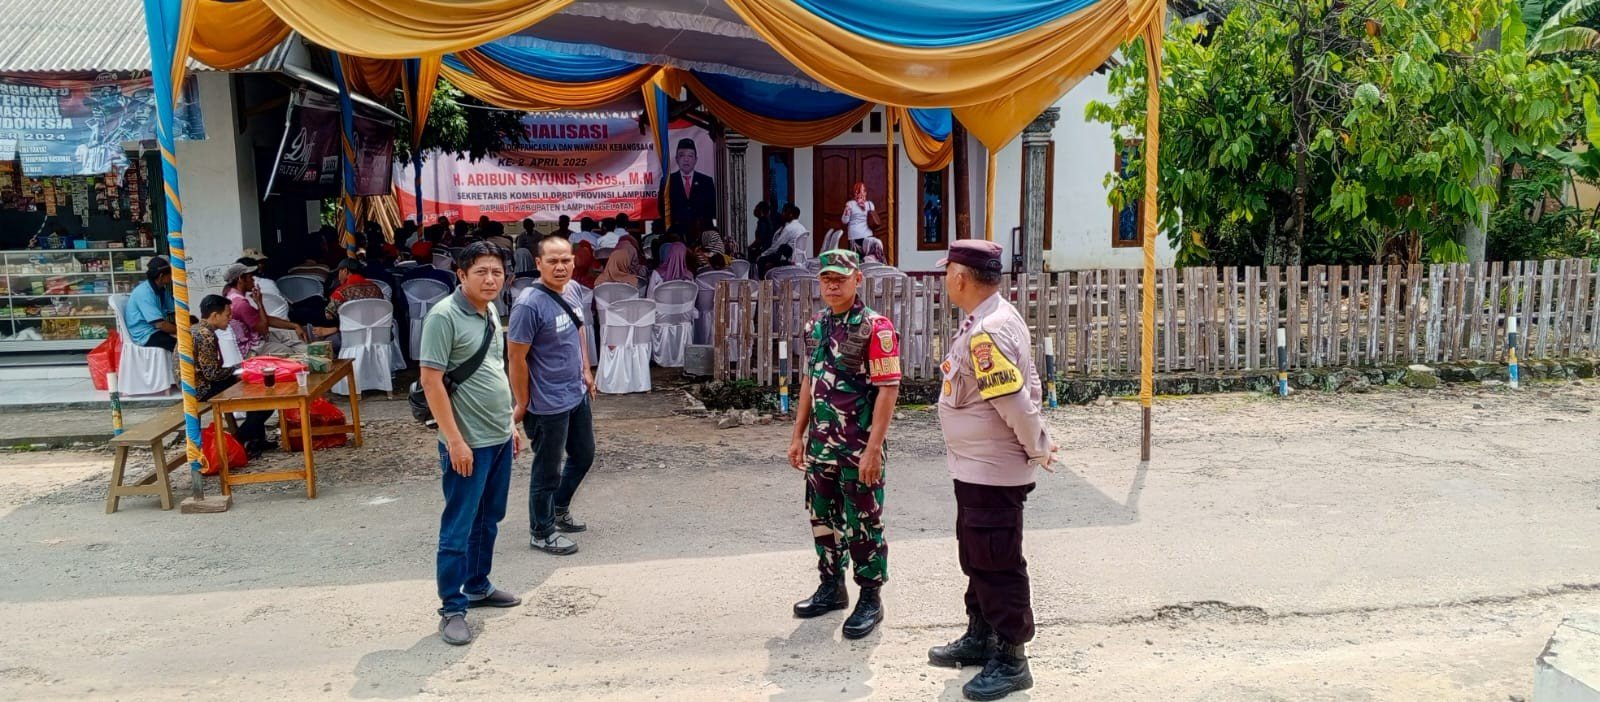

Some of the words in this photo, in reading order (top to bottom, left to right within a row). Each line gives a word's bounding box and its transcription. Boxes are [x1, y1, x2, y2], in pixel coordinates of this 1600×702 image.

[0, 118, 73, 129] DONESIA
[499, 122, 608, 139] SIALISASI
[559, 143, 572, 151] DAN
[573, 143, 607, 151] WAWASAN
[610, 143, 653, 151] KEBANGSAAN
[519, 158, 526, 166] 2
[529, 158, 560, 167] APRIL
[563, 158, 588, 167] 2025
[453, 173, 464, 186] H.
[467, 173, 517, 186] ARIBUN
[521, 172, 580, 188] SAYUNIS,
[629, 171, 654, 185] M.M
[457, 192, 508, 200] SEKRETARIS
[510, 192, 540, 200] KOMISI
[550, 191, 573, 199] DPRD
[575, 191, 615, 199] PROVINSI
[617, 190, 657, 198] LAMPUNG
[562, 203, 599, 211] LAMPUNG
